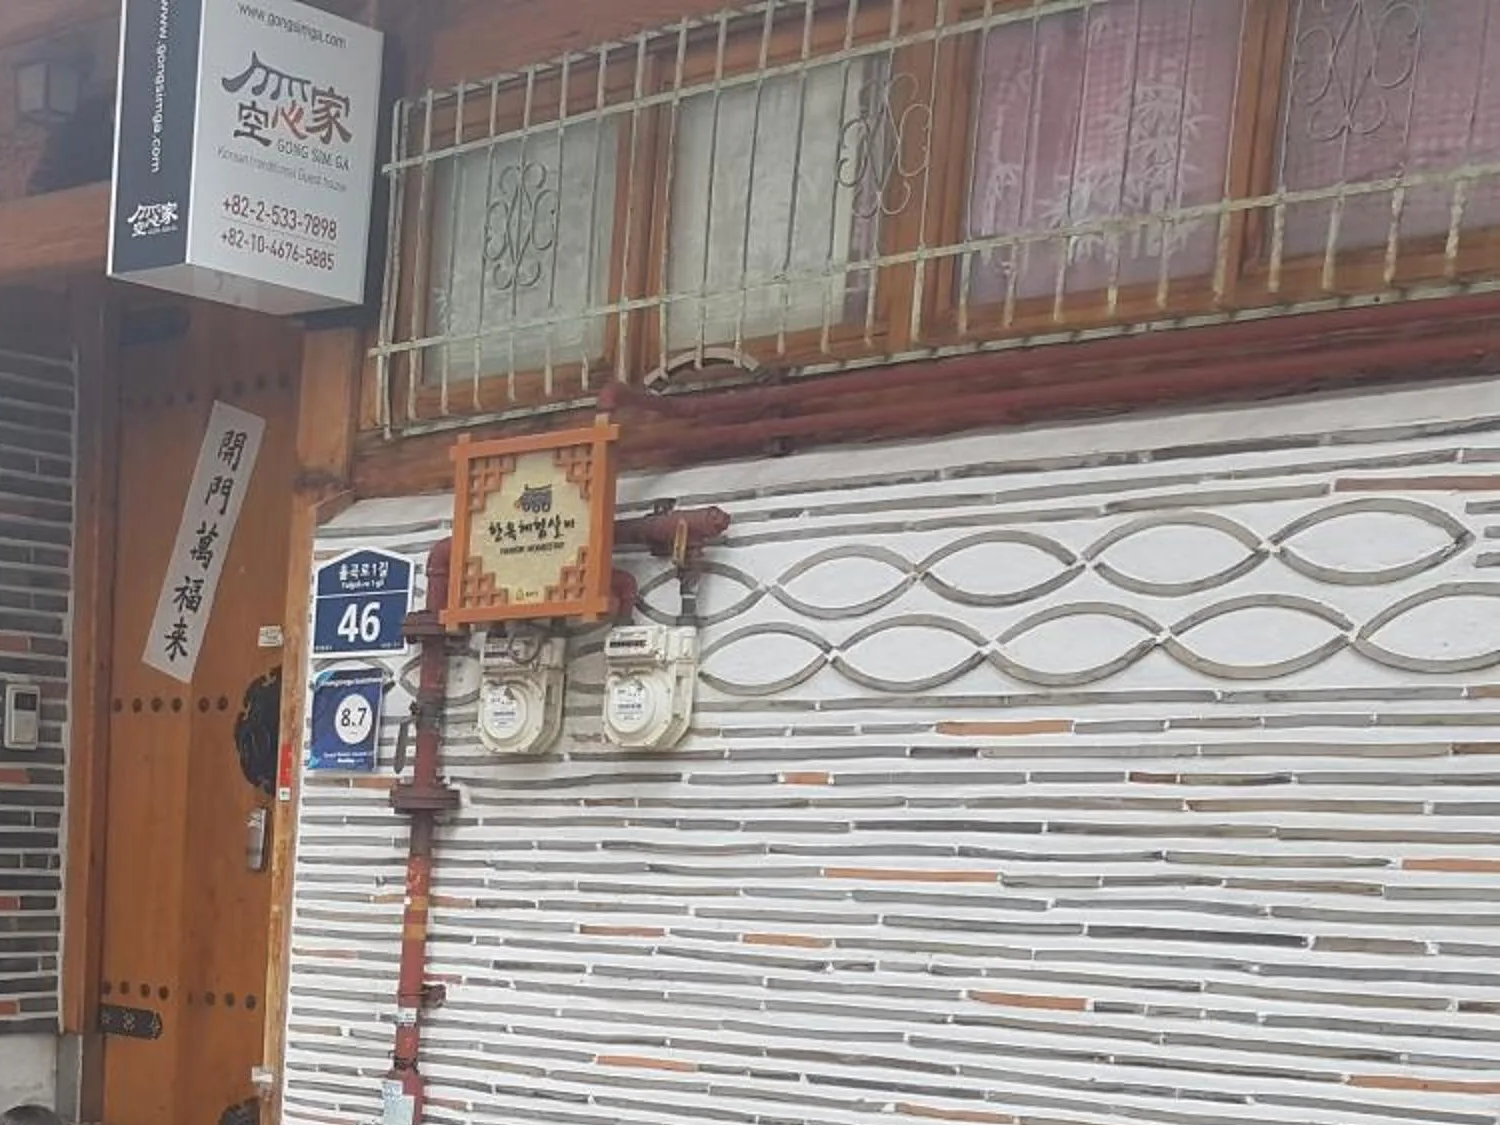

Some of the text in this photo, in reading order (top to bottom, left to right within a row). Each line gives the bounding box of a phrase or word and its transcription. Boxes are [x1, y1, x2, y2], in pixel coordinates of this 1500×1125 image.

[276, 138, 309, 159] GONG
[222, 194, 337, 241] +82-2-533-7898
[337, 601, 381, 643] 46
[341, 707, 368, 727] 8.7
